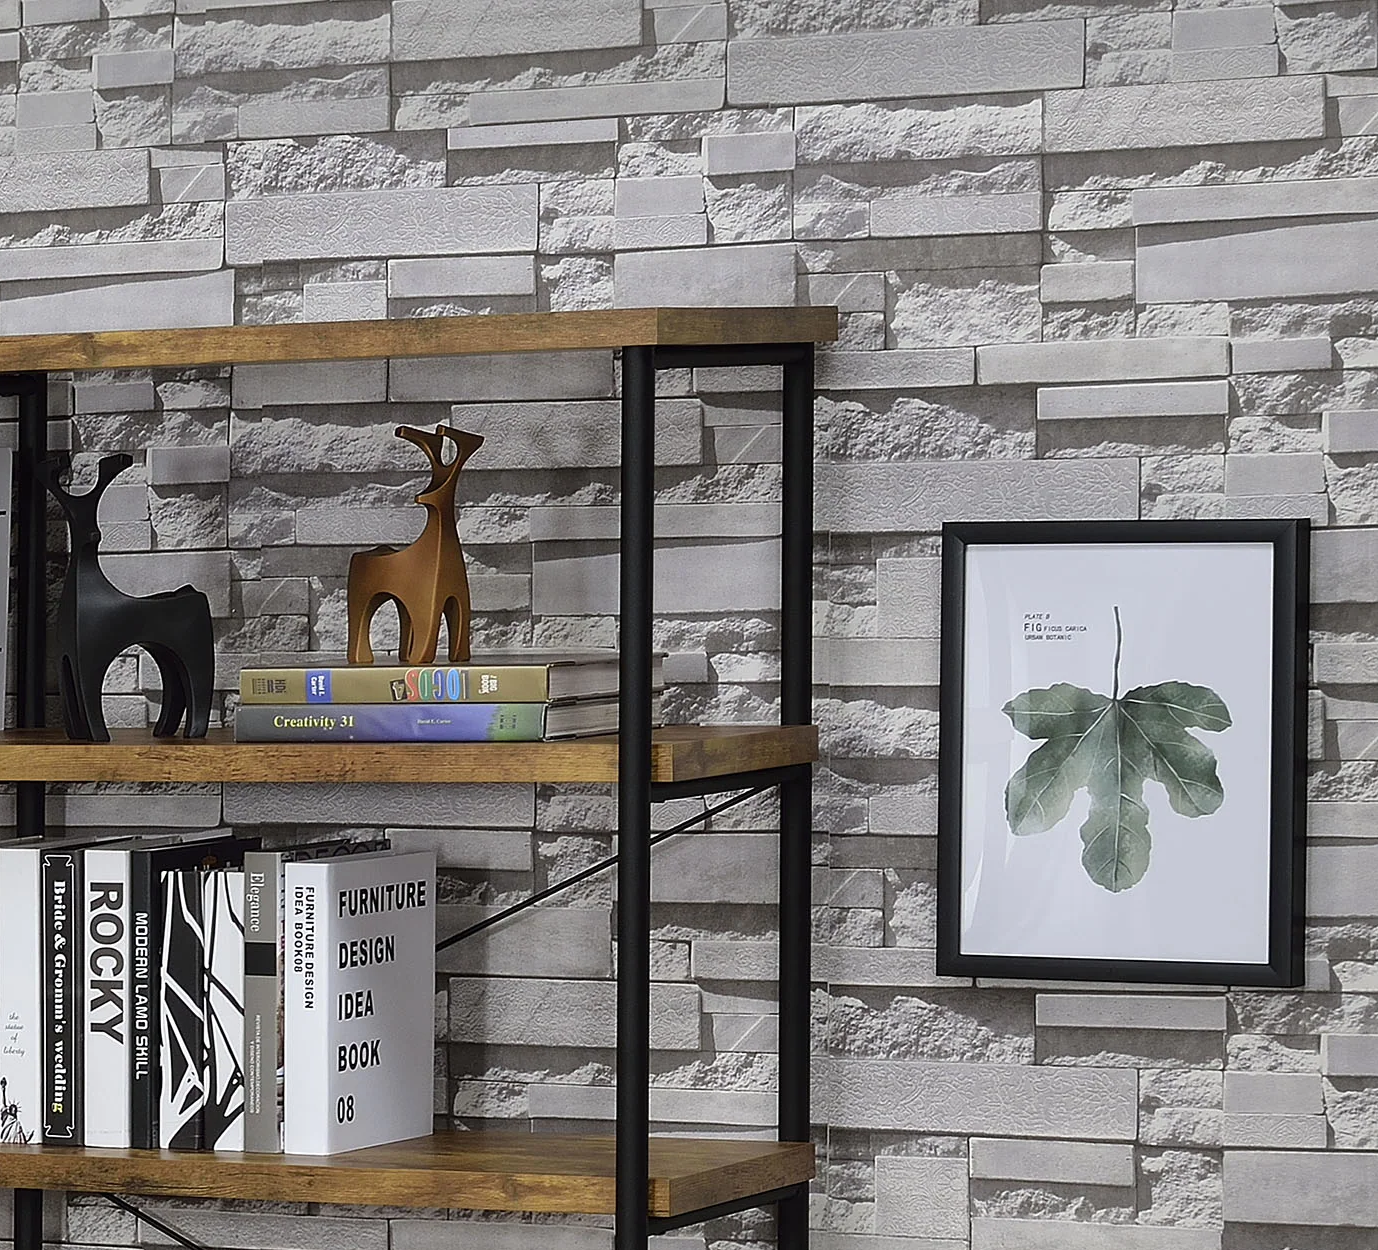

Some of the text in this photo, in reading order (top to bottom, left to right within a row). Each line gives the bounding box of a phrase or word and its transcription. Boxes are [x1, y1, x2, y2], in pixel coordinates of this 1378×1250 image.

[1024, 622, 1042, 632] FIG
[405, 668, 470, 701] LOGOS
[273, 714, 355, 730] Creativity 31
[53, 880, 66, 931] Bride
[246, 872, 264, 933] Elegance
[295, 886, 304, 916] IDEA
[338, 881, 426, 918] FURNITURE
[53, 934, 66, 950] &
[304, 886, 315, 1009] FURNITURE DESIGN
[338, 935, 395, 969] DESIGN
[89, 881, 125, 1045] ROCKY
[134, 912, 149, 1080] MODERN LAMO SKILL
[337, 990, 374, 1021] IDEA
[11, 1032, 18, 1043] of
[337, 1040, 381, 1072] BOOK
[50, 1040, 67, 1114] wedding
[337, 1095, 355, 1124] 08
